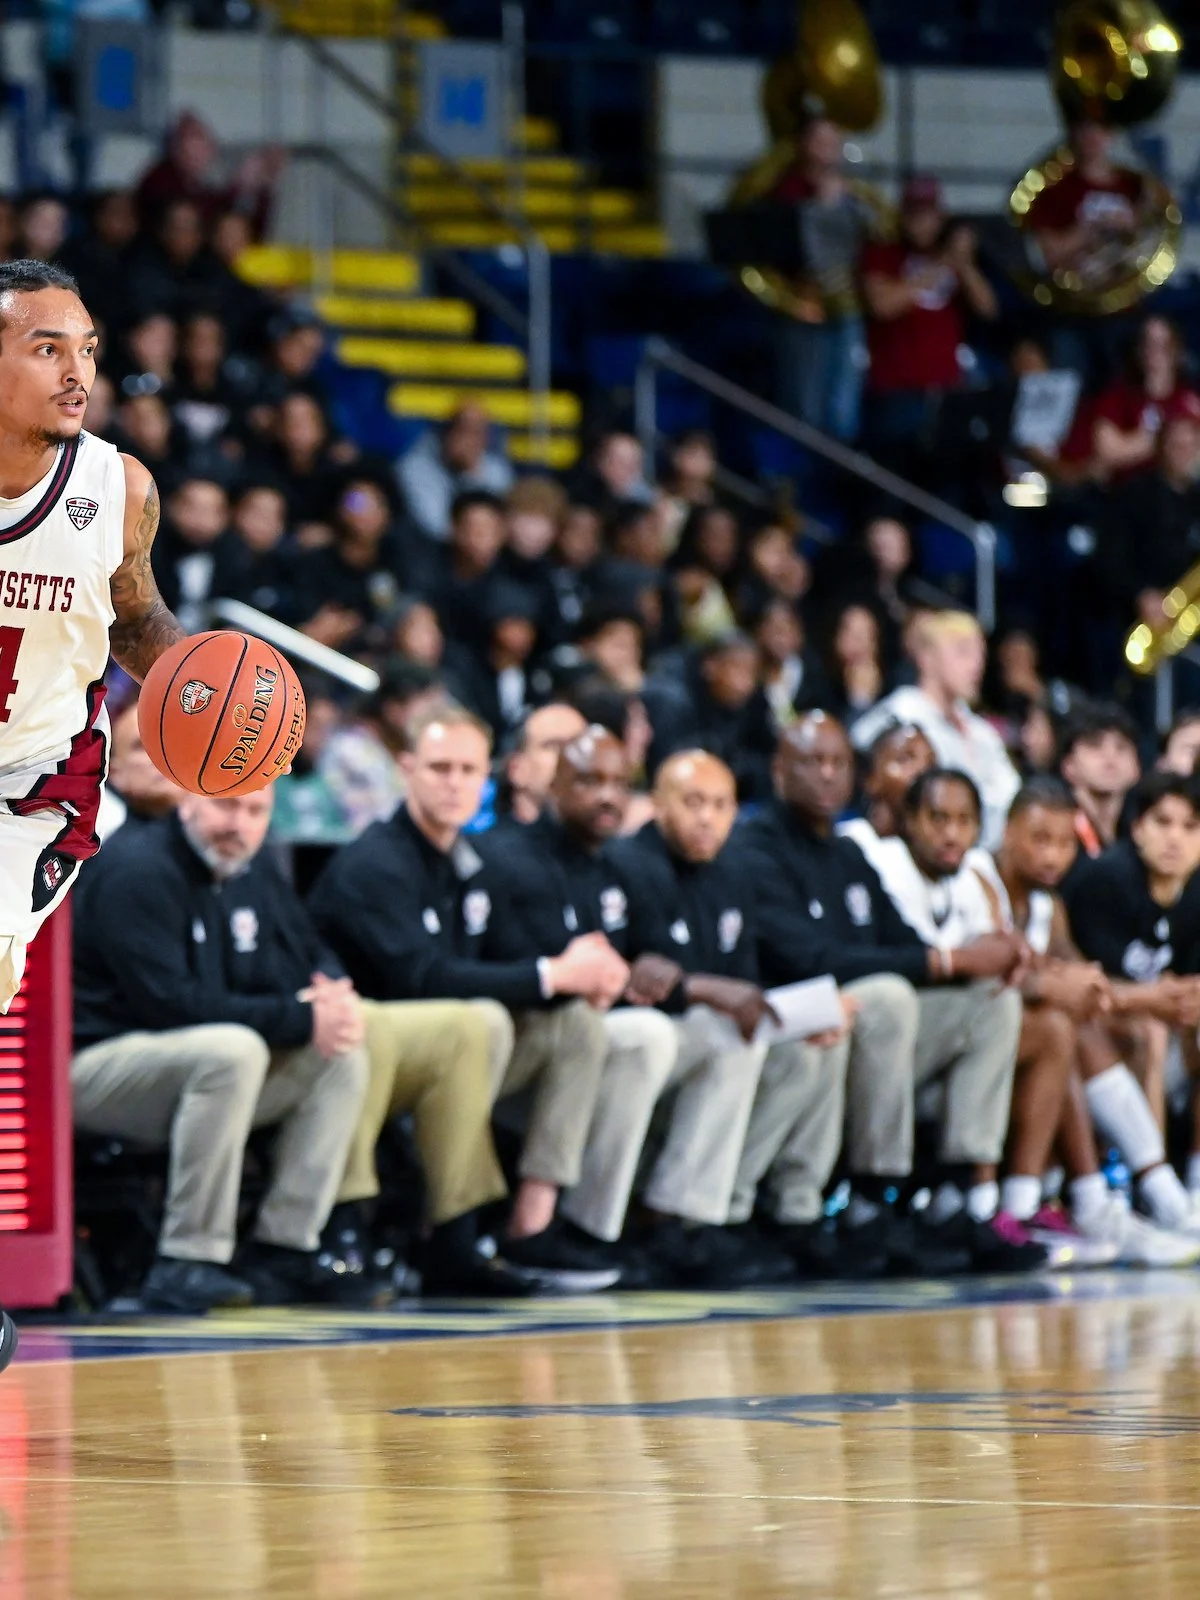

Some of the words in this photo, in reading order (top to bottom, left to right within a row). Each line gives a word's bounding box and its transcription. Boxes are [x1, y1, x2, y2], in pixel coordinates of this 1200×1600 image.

[68, 506, 97, 518] MAC
[220, 664, 279, 777] SPALDING
[261, 685, 303, 778] LEGACY
